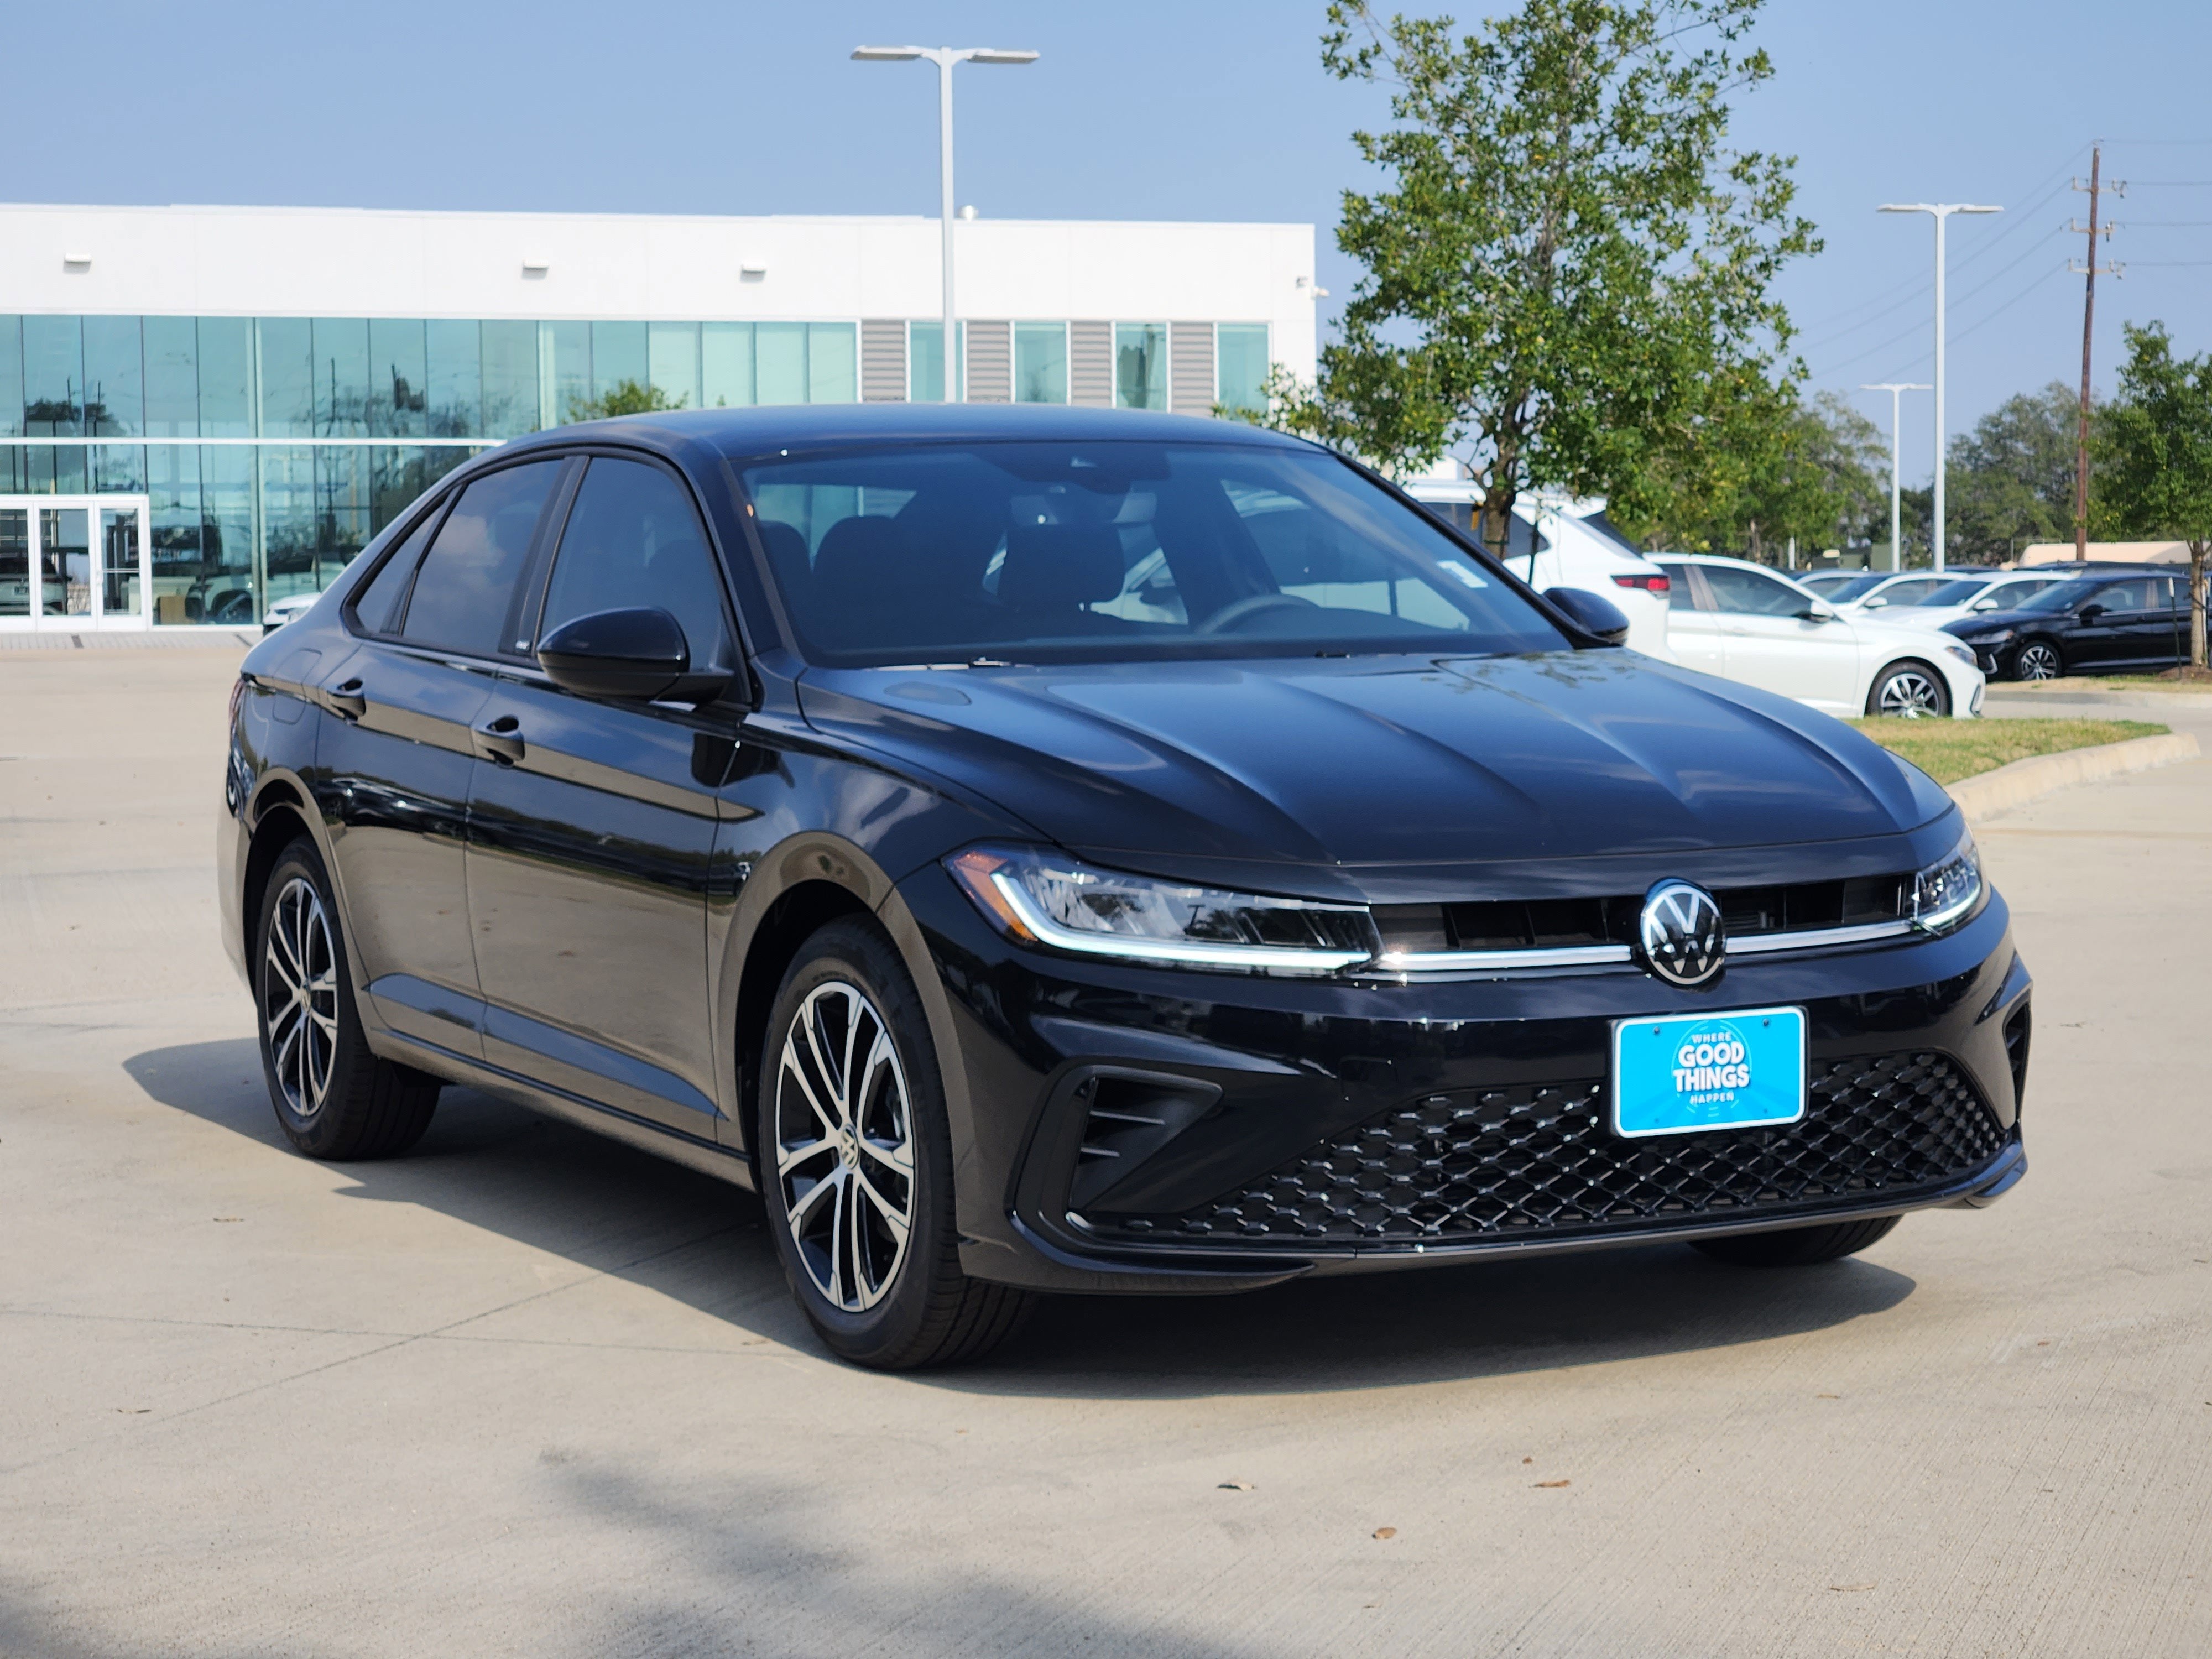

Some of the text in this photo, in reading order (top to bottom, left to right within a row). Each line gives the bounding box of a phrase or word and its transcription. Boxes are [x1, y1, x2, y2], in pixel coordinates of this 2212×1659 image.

[1692, 1031, 1731, 1044] WHERE
[1678, 1041, 1745, 1068] GOOD
[1673, 1063, 1750, 1092] THINGS
[1689, 1091, 1734, 1104] HAPPEN
